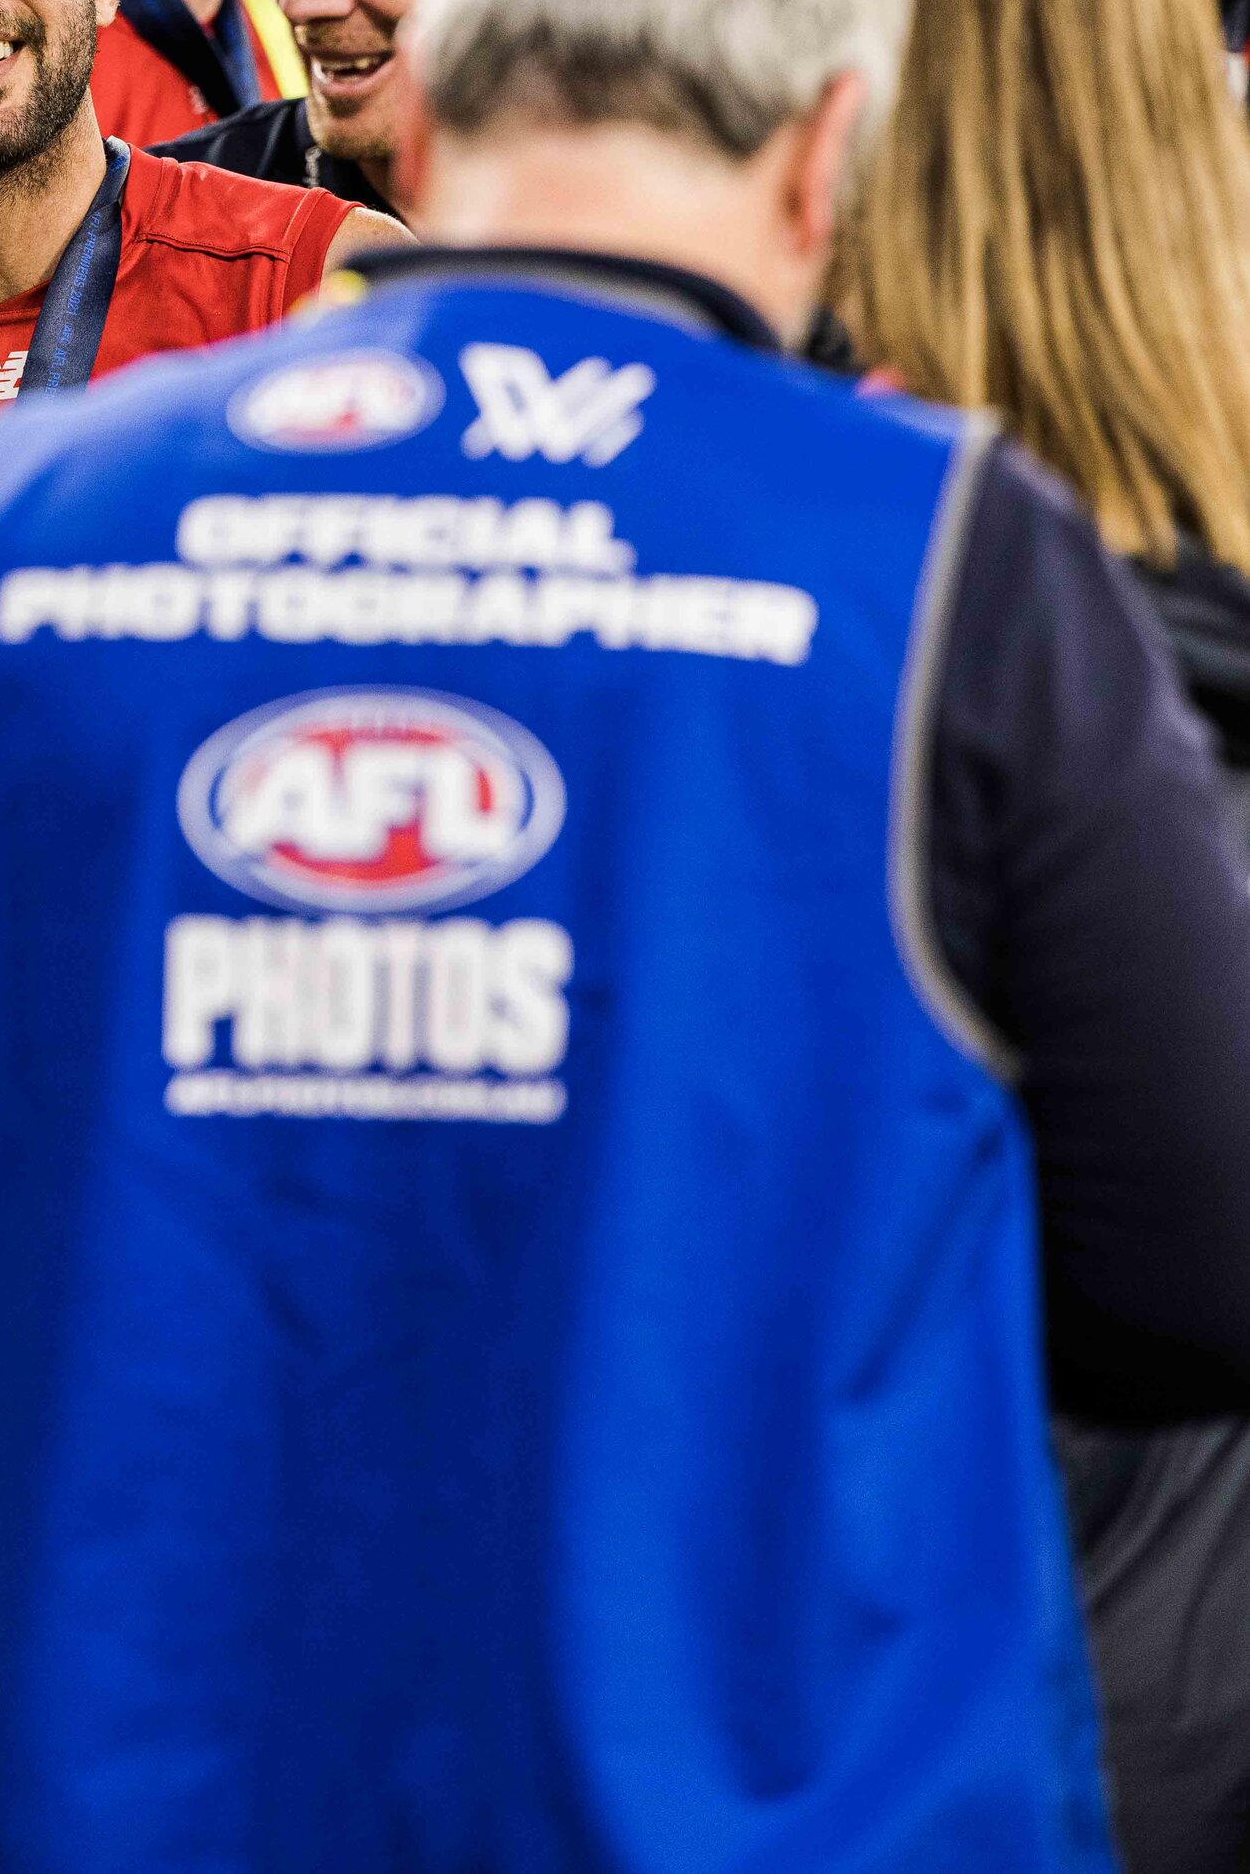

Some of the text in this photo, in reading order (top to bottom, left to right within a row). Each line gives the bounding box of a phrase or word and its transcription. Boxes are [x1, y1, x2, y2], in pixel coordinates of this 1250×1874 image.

[73, 231, 98, 288] PREMIERS
[176, 493, 639, 576] OFFICIAL
[223, 738, 524, 861] AFL
[163, 915, 573, 1072] PHOTOS
